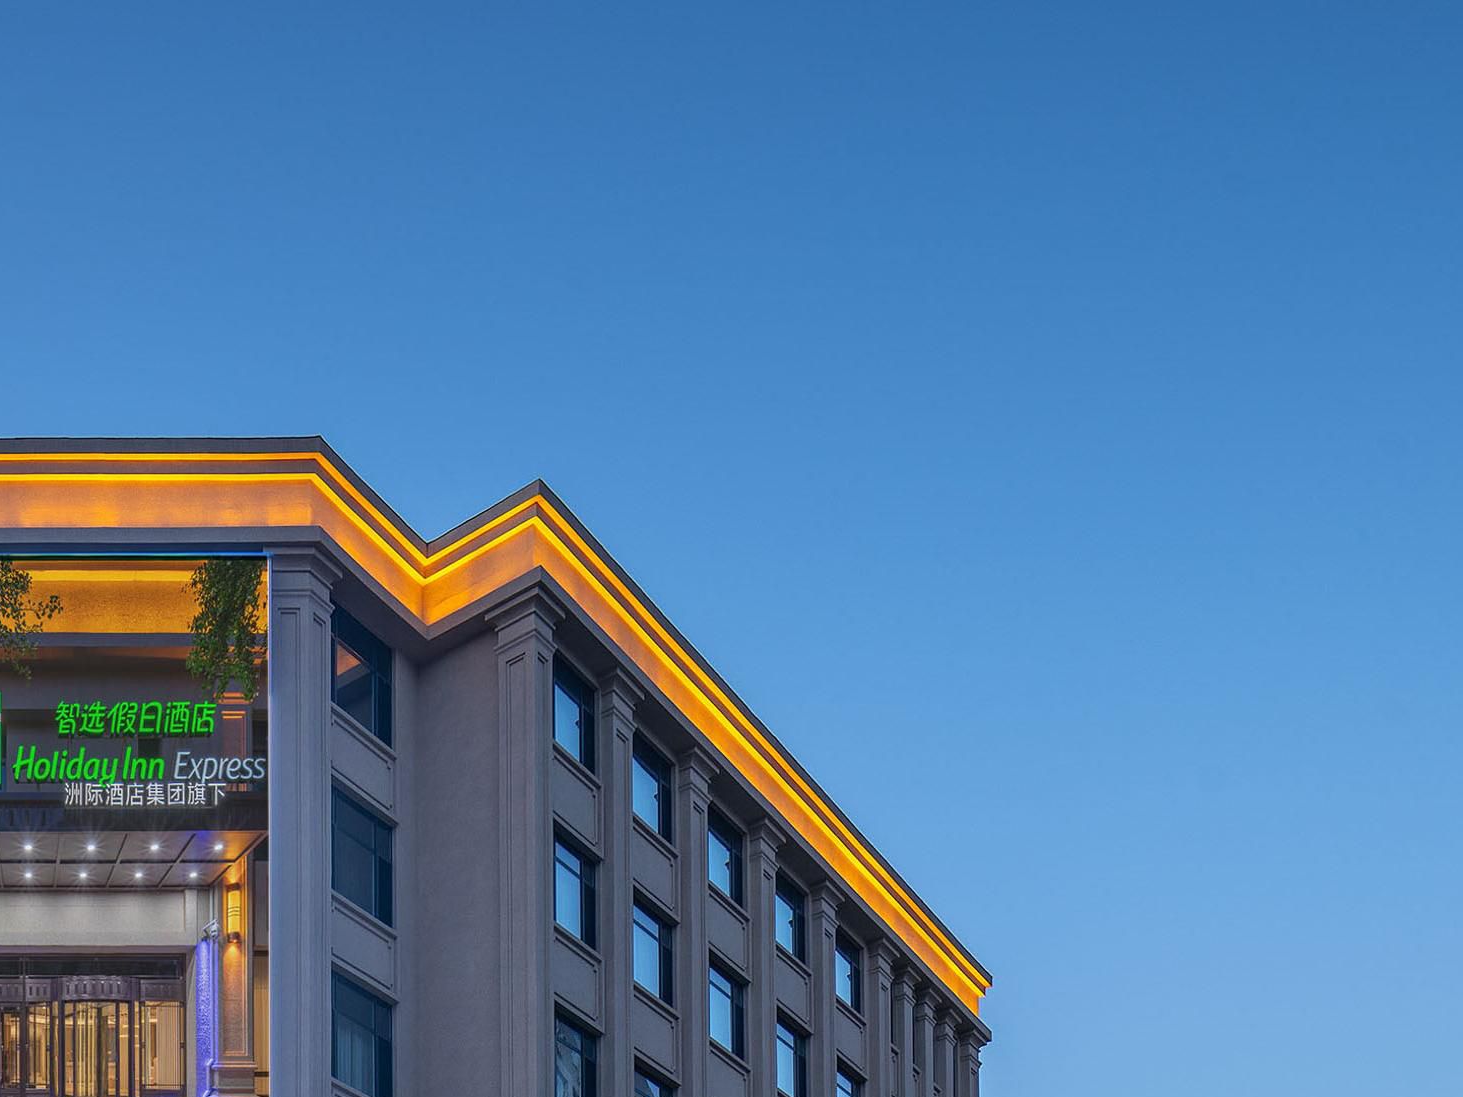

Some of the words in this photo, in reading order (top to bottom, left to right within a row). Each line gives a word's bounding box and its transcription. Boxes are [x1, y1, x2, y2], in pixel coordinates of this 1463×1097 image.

[54, 699, 218, 735] 智选假日酒店
[12, 744, 119, 787] Holiday
[121, 745, 166, 781] Inn
[173, 750, 267, 784] Express
[64, 782, 227, 807] 洲际酒店集团旗下
